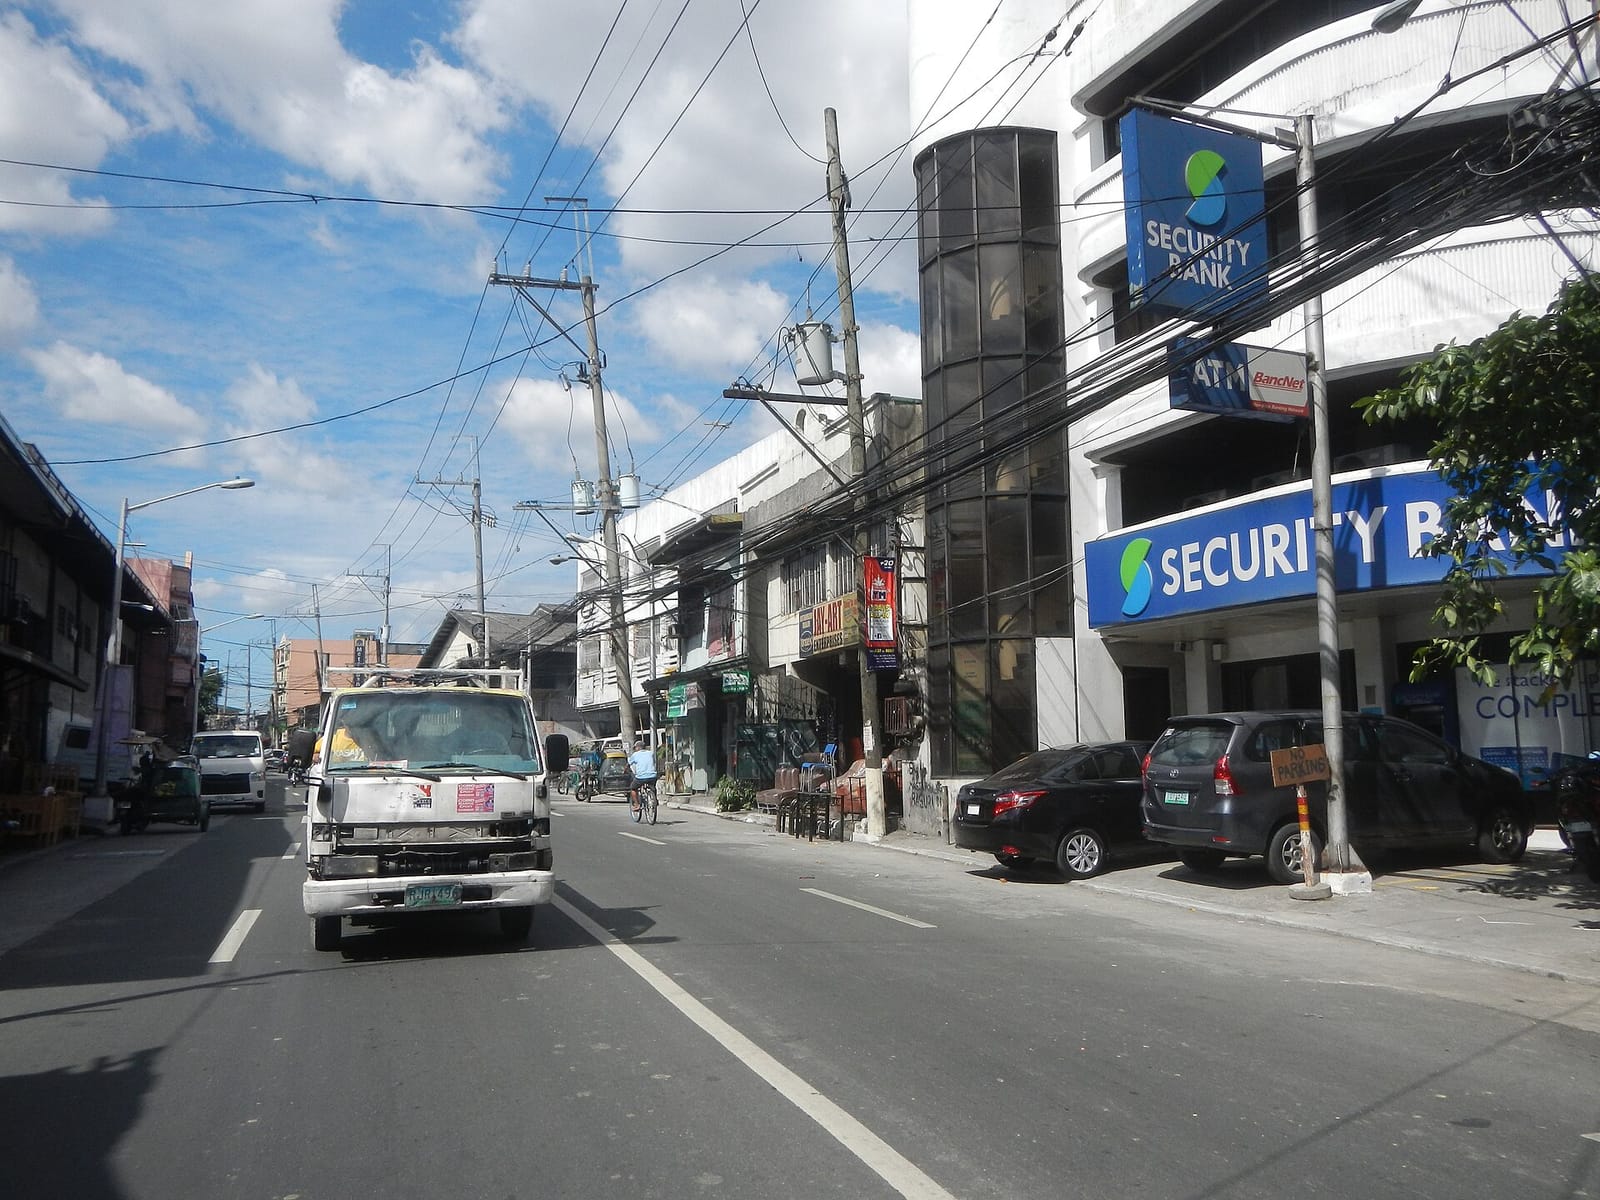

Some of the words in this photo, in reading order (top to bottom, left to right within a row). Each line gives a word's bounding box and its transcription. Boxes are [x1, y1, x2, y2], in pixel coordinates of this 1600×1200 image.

[1147, 220, 1250, 266] SECURITY
[1169, 253, 1233, 290] BANK
[1192, 358, 1246, 392] ATM
[1253, 371, 1305, 390] BancNet
[1278, 757, 1327, 779] PARKING
[1289, 748, 1305, 761] NO
